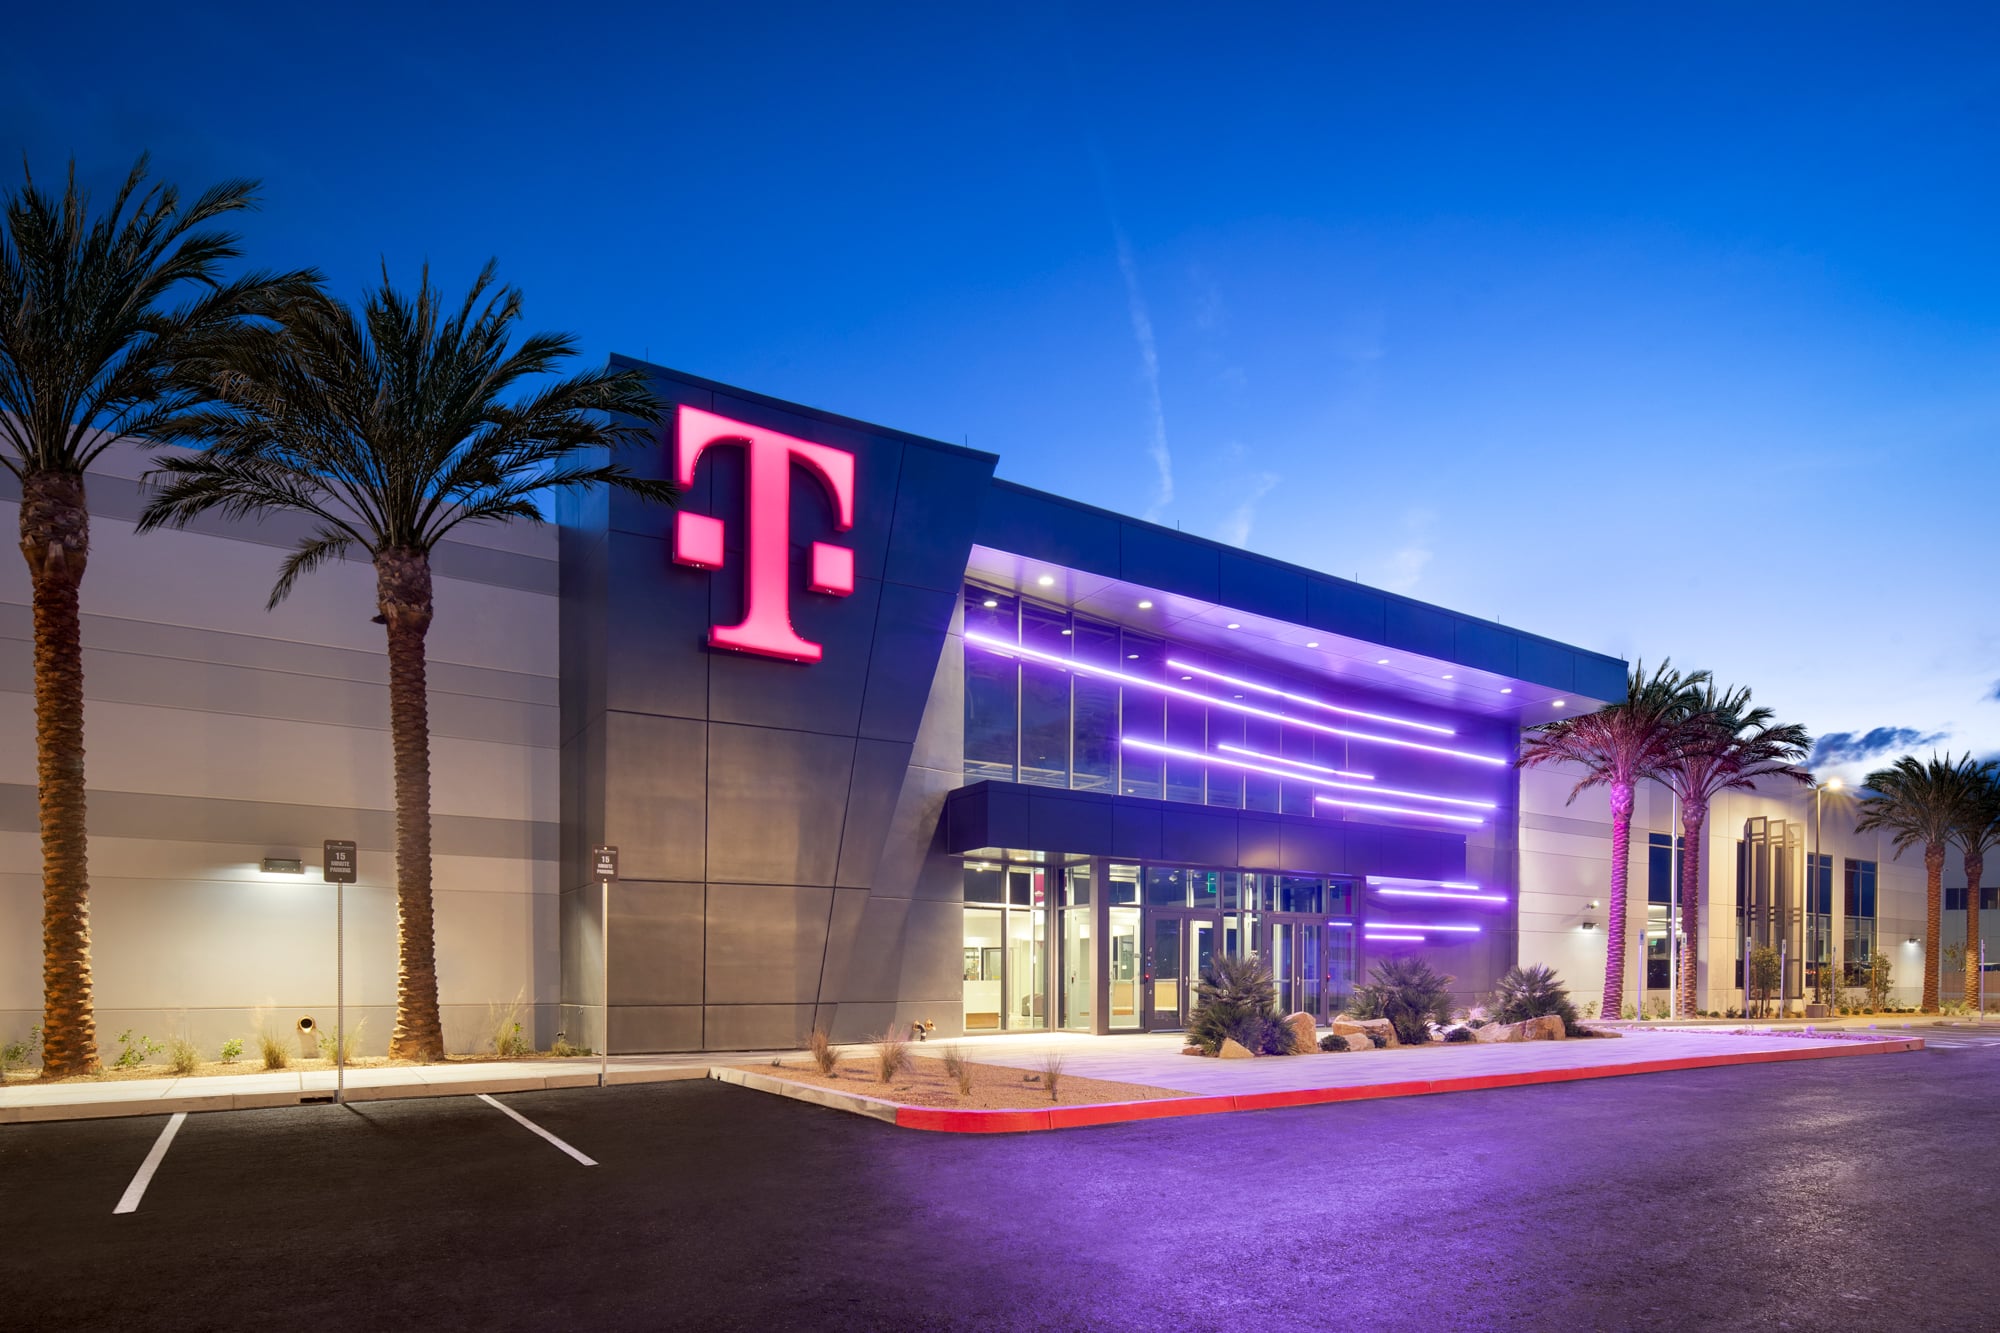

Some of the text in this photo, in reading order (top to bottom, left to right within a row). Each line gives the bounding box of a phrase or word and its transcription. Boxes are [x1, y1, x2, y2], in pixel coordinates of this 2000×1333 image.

[673, 403, 855, 664] T
[335, 852, 346, 860] 15
[601, 855, 610, 863] 15
